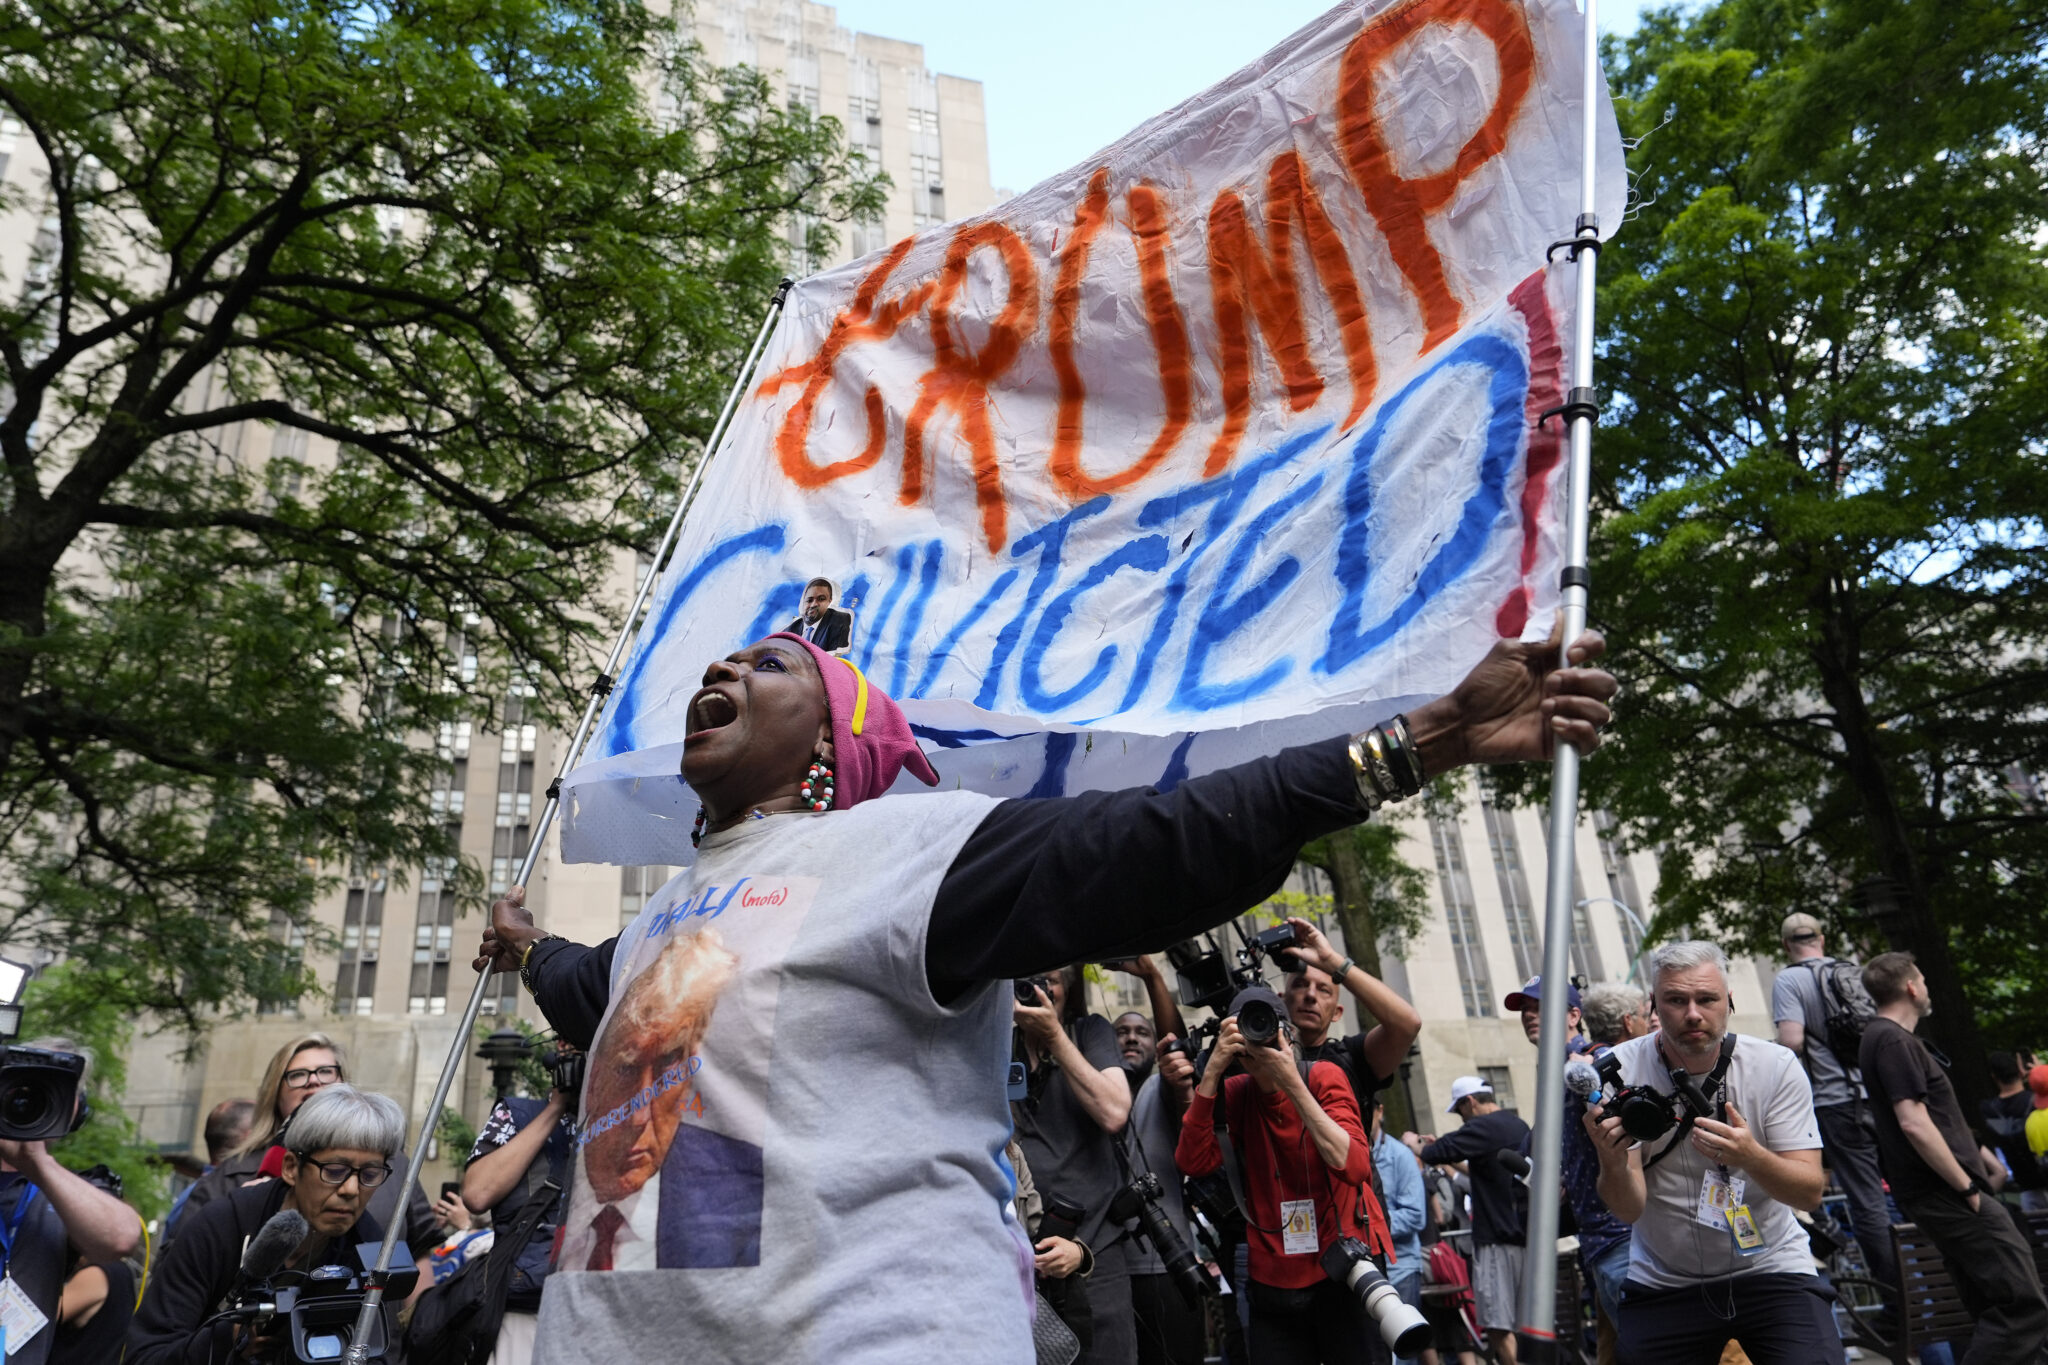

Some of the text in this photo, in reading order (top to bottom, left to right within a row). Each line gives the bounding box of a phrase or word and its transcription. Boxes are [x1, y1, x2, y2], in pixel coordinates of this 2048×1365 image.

[755, 0, 1536, 559] TRUMP
[742, 887, 788, 908] (mofo)
[576, 1055, 703, 1152] SURRENDERED
